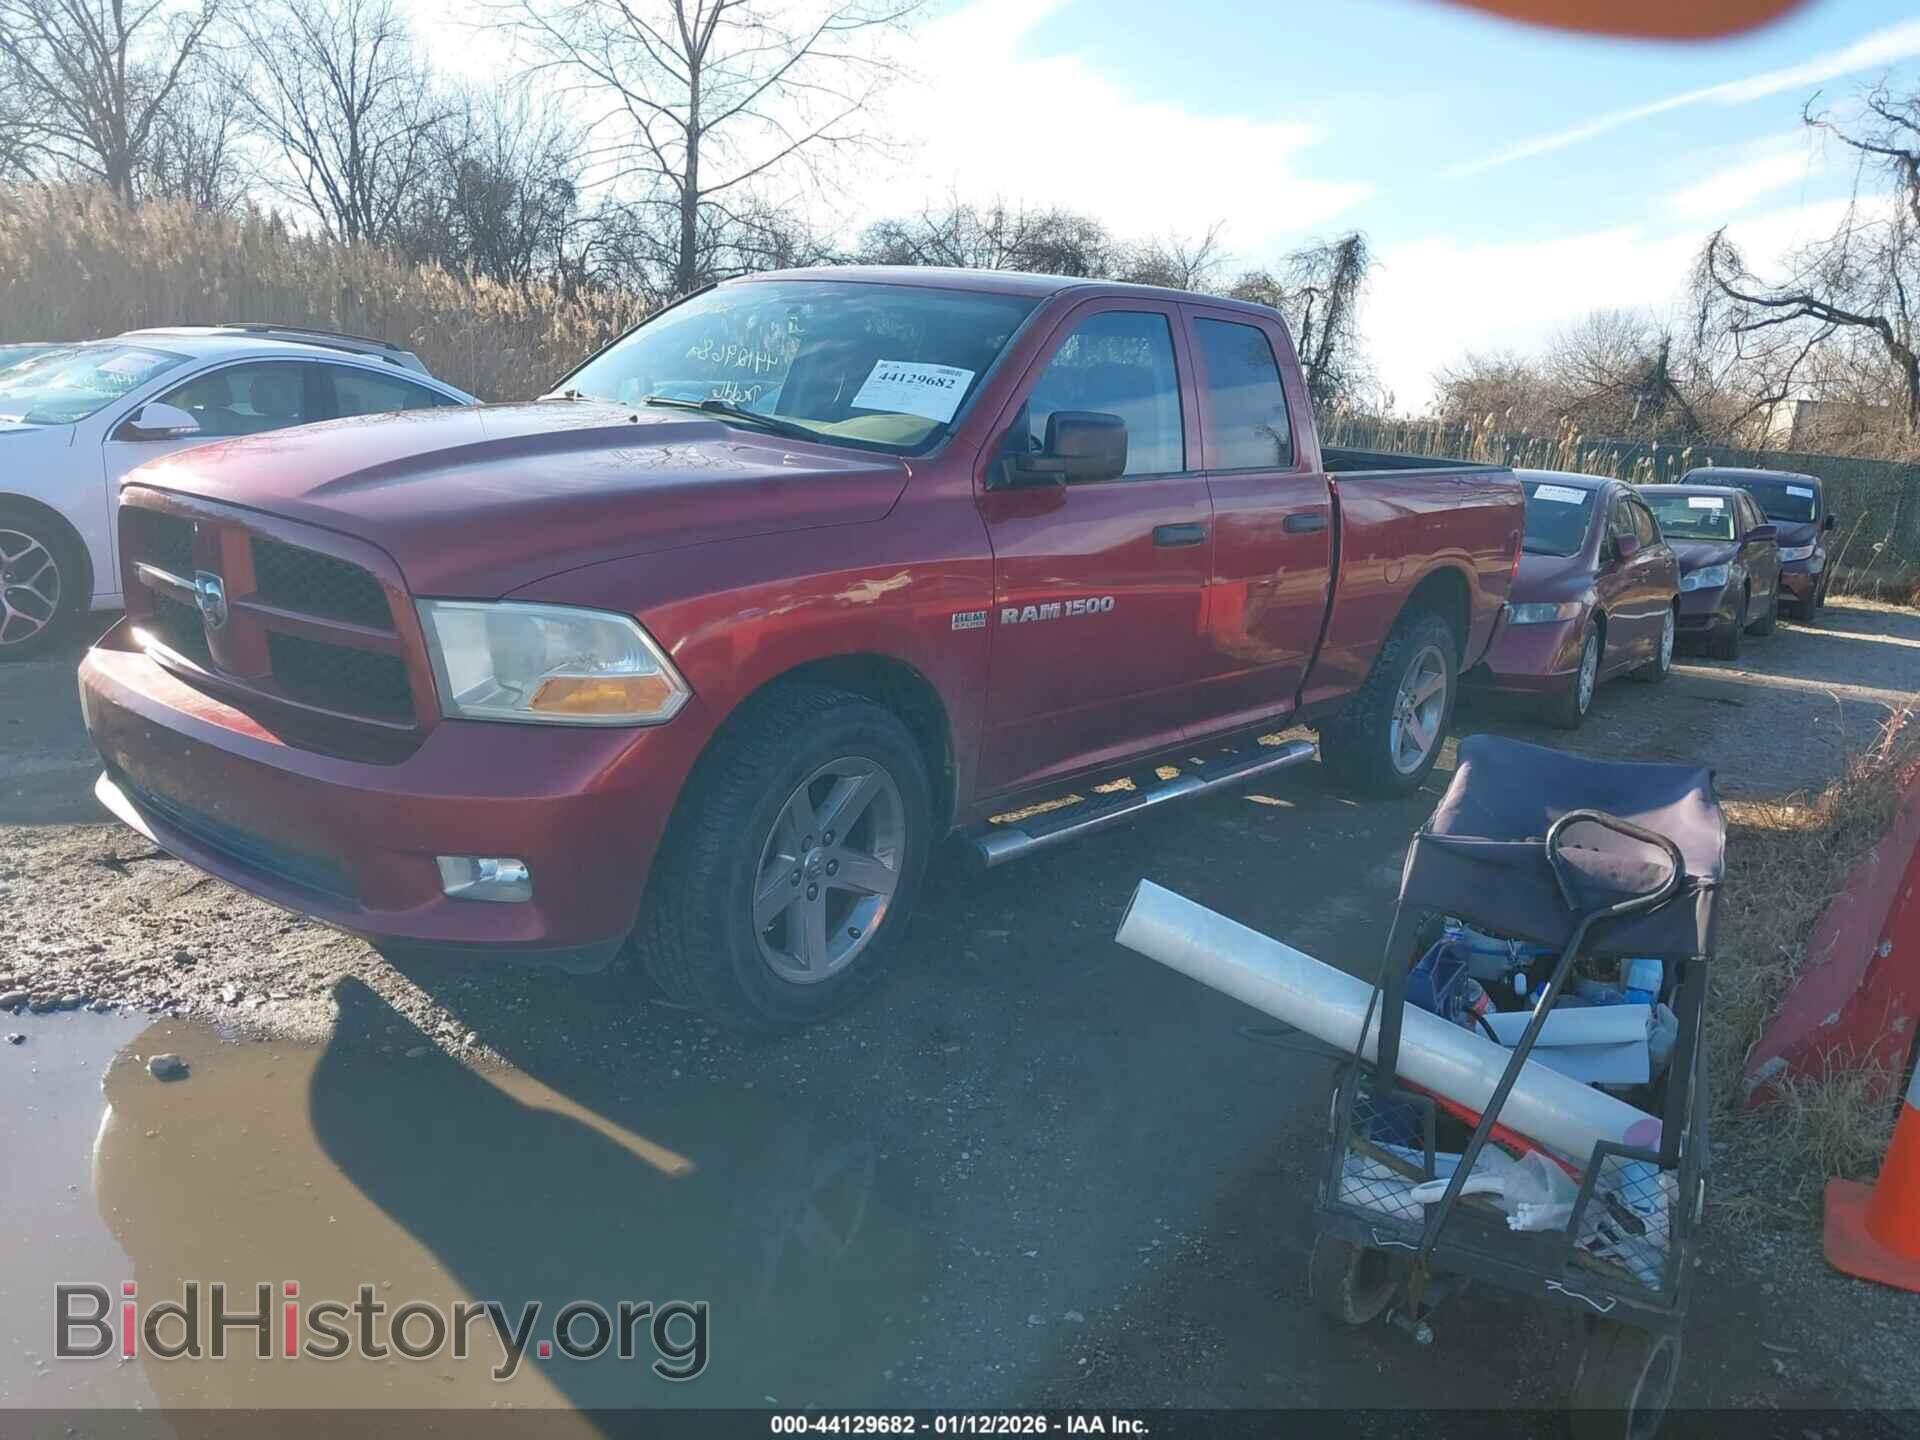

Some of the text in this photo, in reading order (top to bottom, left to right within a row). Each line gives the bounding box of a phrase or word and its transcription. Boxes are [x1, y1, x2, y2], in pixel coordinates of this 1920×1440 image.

[879, 371, 956, 390] 44129682
[1001, 596, 1115, 625] RAM 1500
